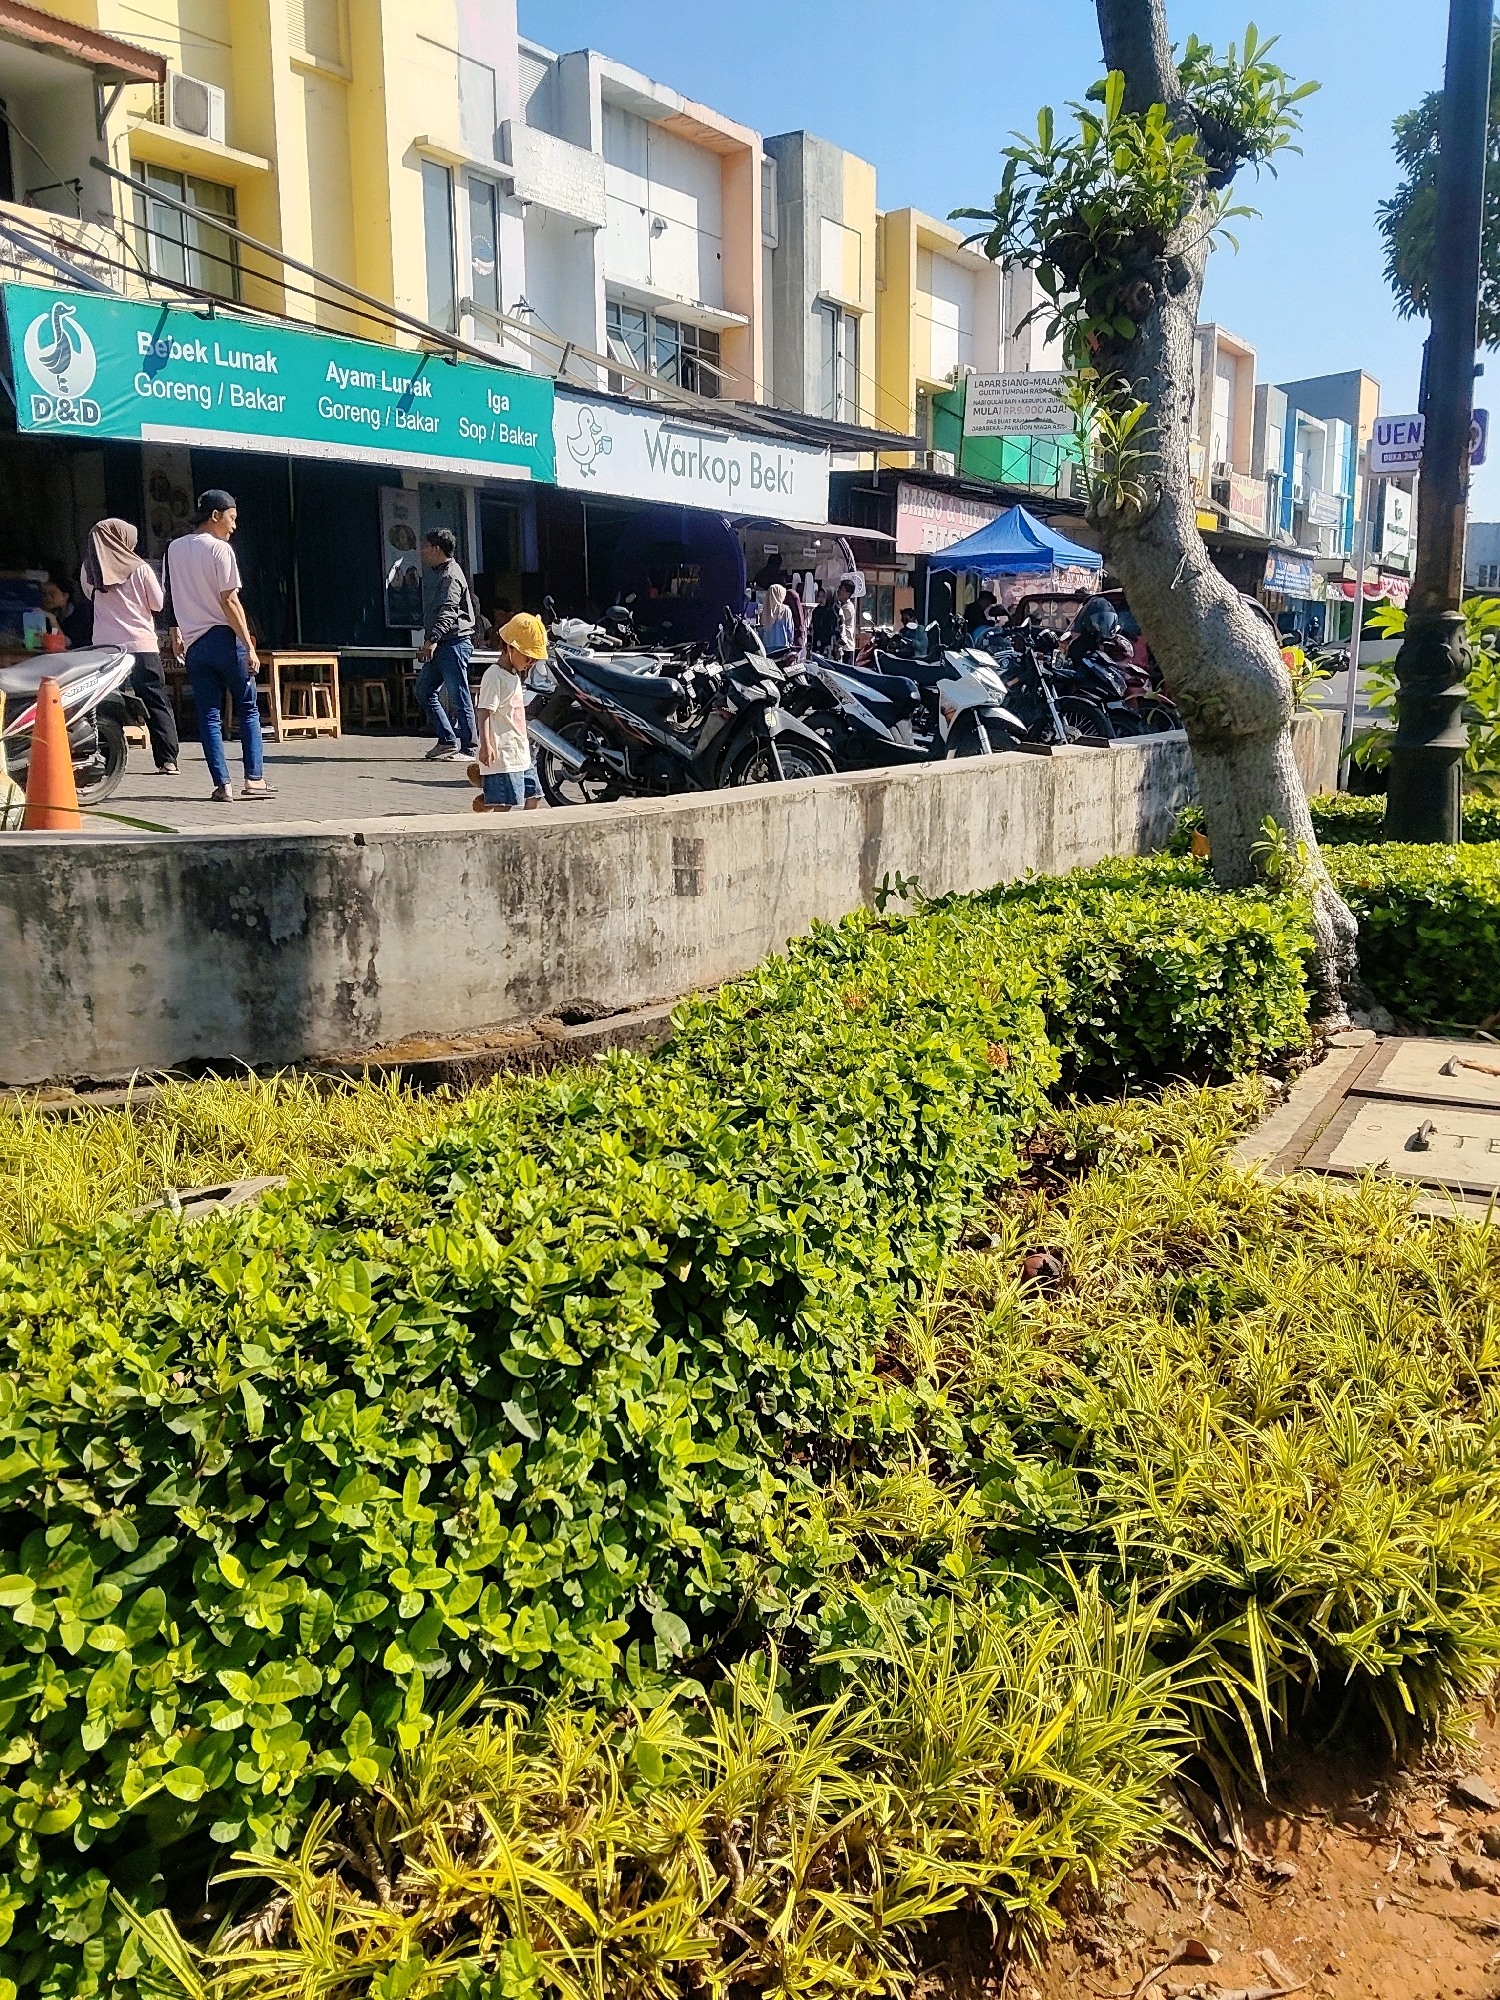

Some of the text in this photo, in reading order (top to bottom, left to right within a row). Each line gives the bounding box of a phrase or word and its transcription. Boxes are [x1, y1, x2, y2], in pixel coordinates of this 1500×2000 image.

[137, 331, 278, 374] Bebek Lunak
[134, 372, 286, 413] Goreng / Bakar
[325, 360, 432, 398] Ayam Lunak
[974, 380, 1000, 388] LAPAR
[1002, 388, 1029, 396] TUMPAH
[30, 395, 101, 426] D&D
[318, 396, 440, 433] Goreng / Bakar
[487, 389, 510, 415] Iga
[973, 406, 1002, 415] MULAI
[1045, 405, 1067, 414] AJA!
[459, 416, 538, 448] Sop / Bakar
[1377, 422, 1422, 446] UEN
[644, 428, 794, 496] Warkop Beki
[900, 486, 943, 521] BAKSO
[946, 498, 957, 523] &
